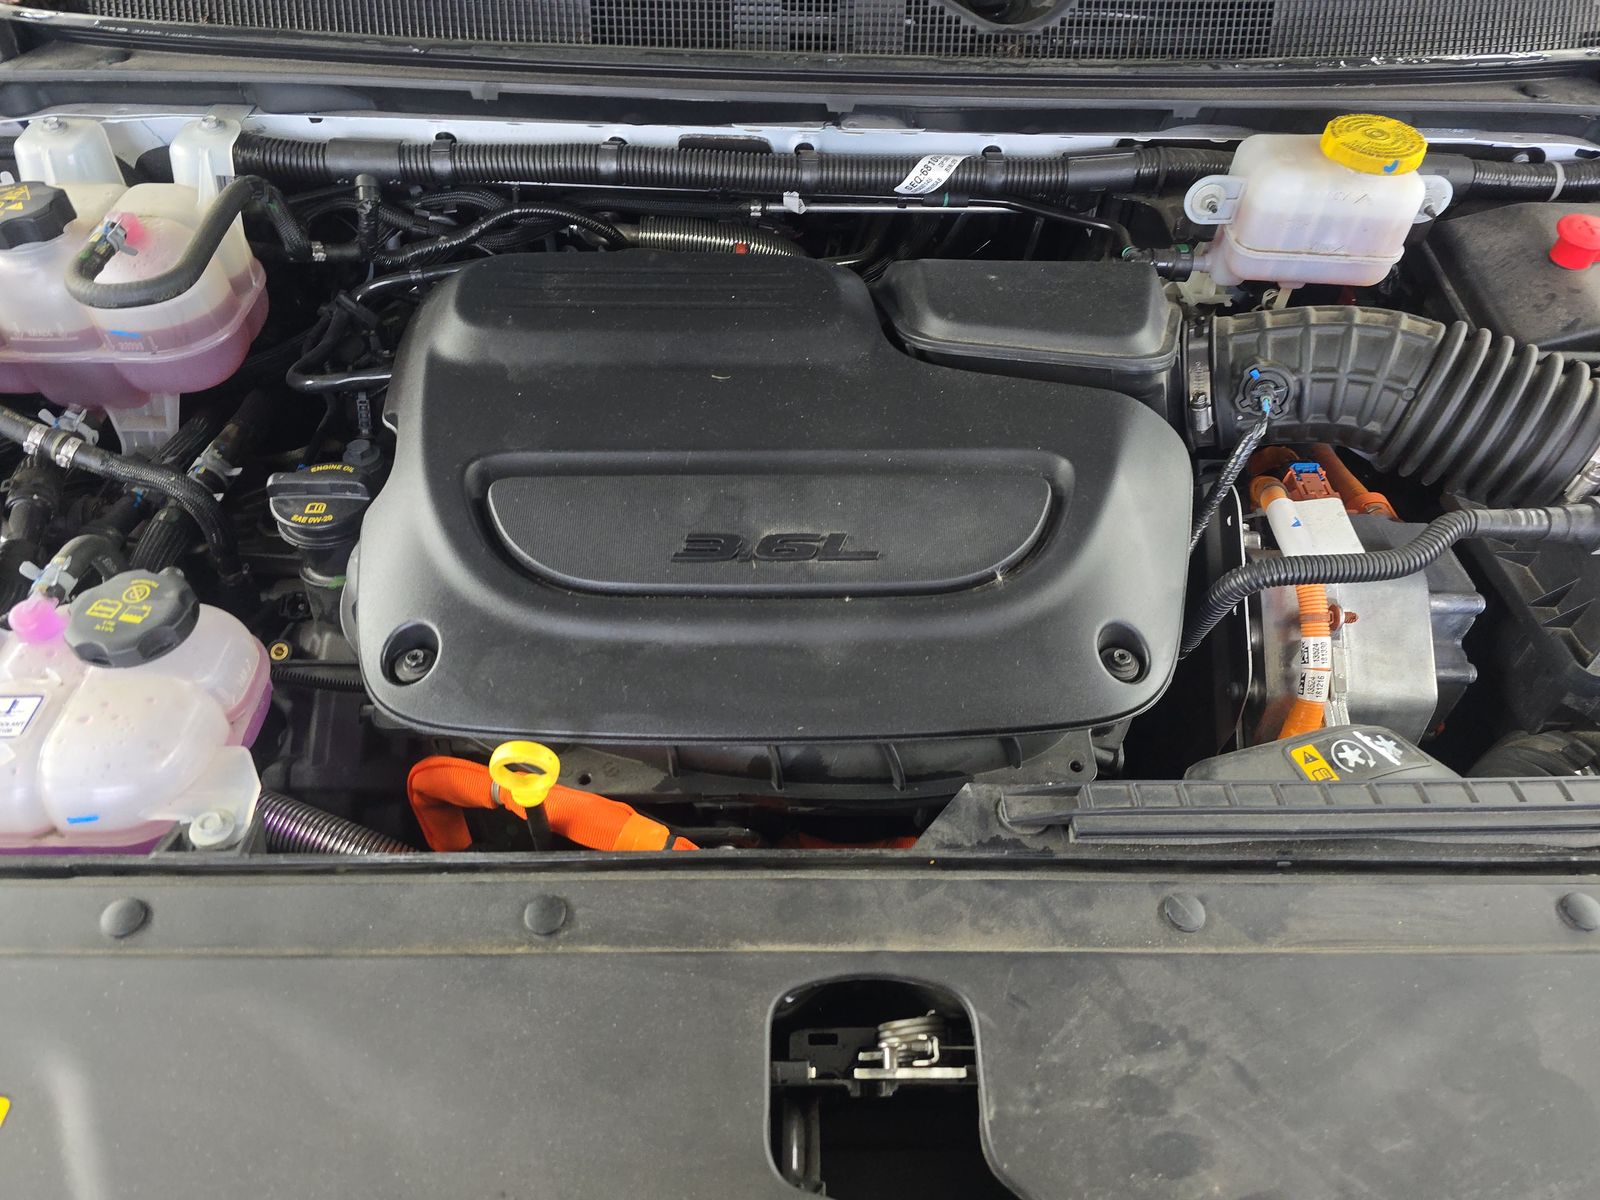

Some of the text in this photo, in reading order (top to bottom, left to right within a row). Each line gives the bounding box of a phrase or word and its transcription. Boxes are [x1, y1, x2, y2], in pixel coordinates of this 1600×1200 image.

[310, 464, 355, 474] ENGINE OIL
[291, 514, 307, 523] SAE
[671, 533, 880, 562] 3.6L
